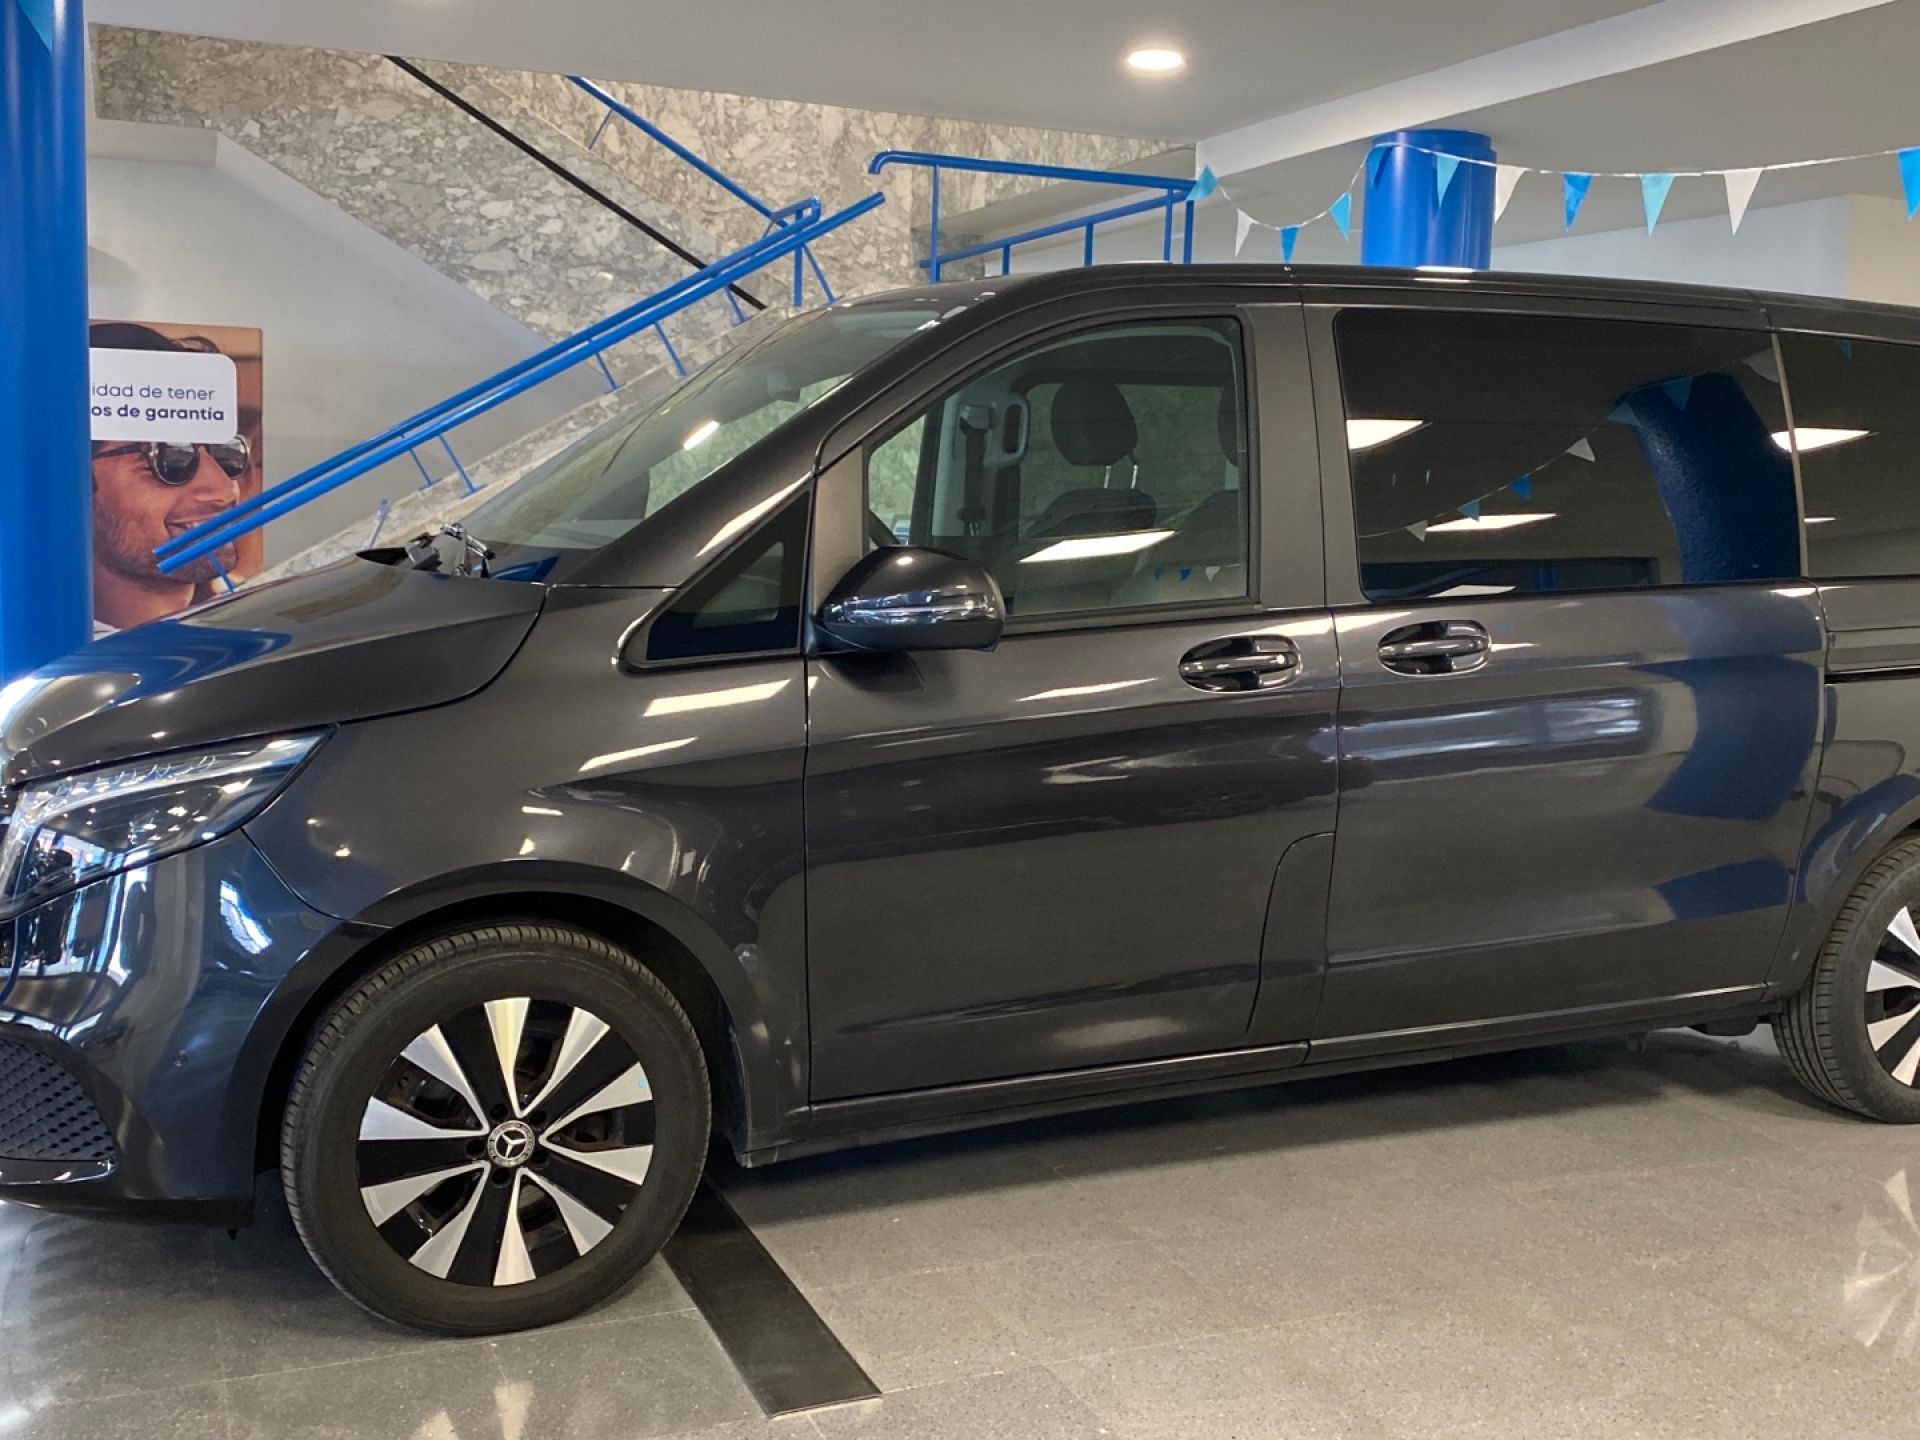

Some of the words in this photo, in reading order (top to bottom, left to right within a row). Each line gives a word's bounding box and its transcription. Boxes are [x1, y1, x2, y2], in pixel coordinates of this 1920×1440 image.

[139, 385, 162, 398] de
[168, 387, 215, 401] tener
[117, 404, 140, 417] de
[145, 406, 225, 421] garantía
